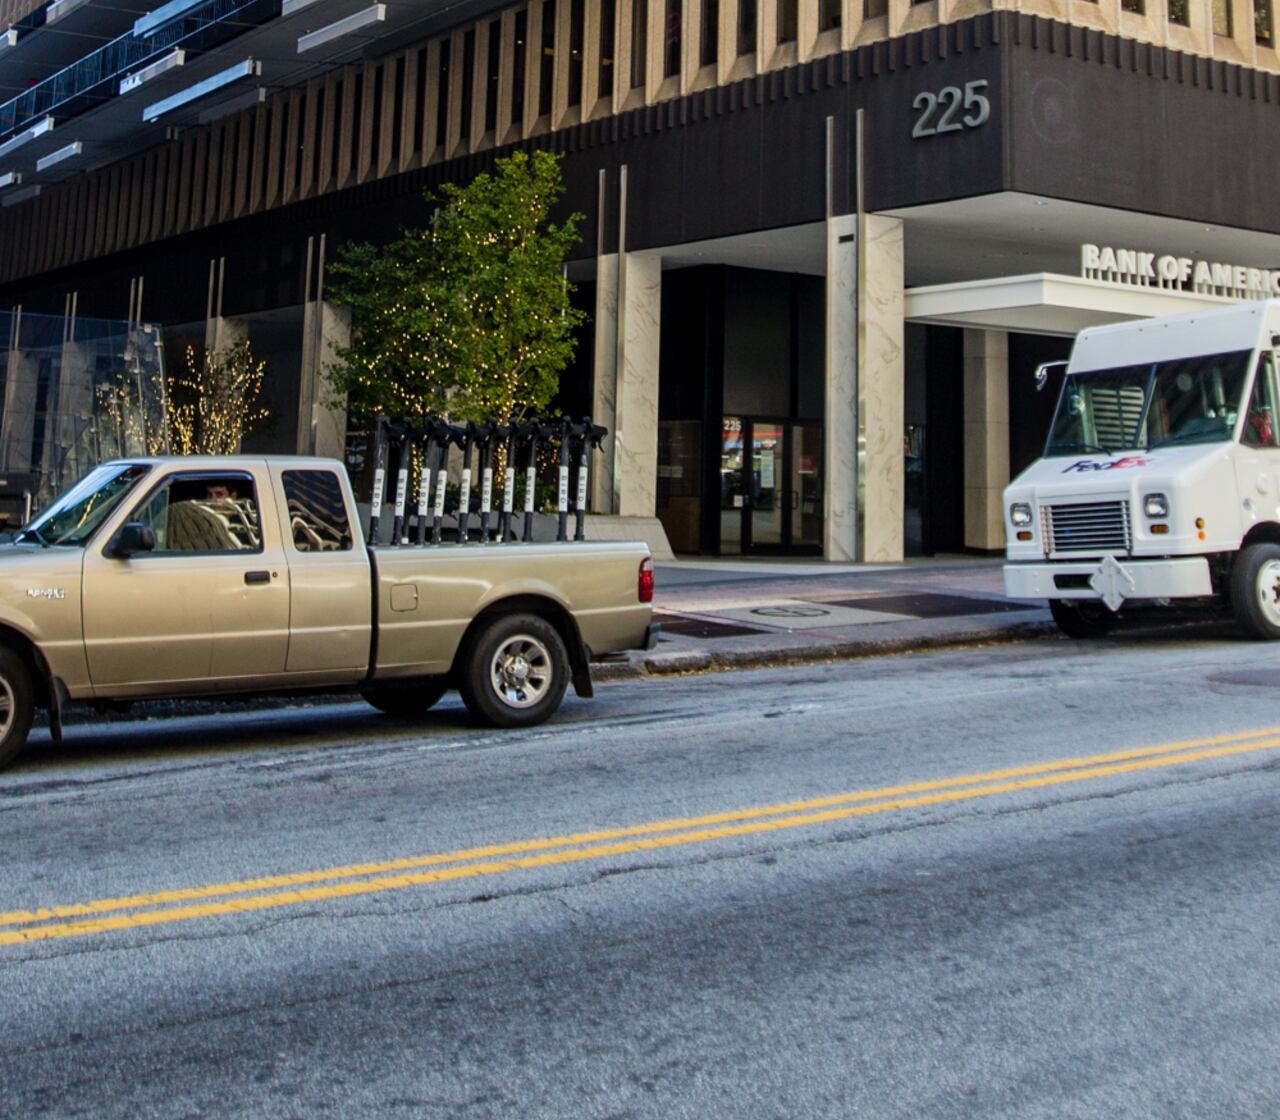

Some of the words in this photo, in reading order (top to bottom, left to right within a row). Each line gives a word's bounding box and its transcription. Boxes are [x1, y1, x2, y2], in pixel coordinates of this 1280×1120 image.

[912, 79, 991, 139] 225
[1081, 243, 1155, 278] BANK
[1157, 255, 1193, 282] OF
[723, 420, 741, 431] 225
[1061, 456, 1153, 474] FedEx
